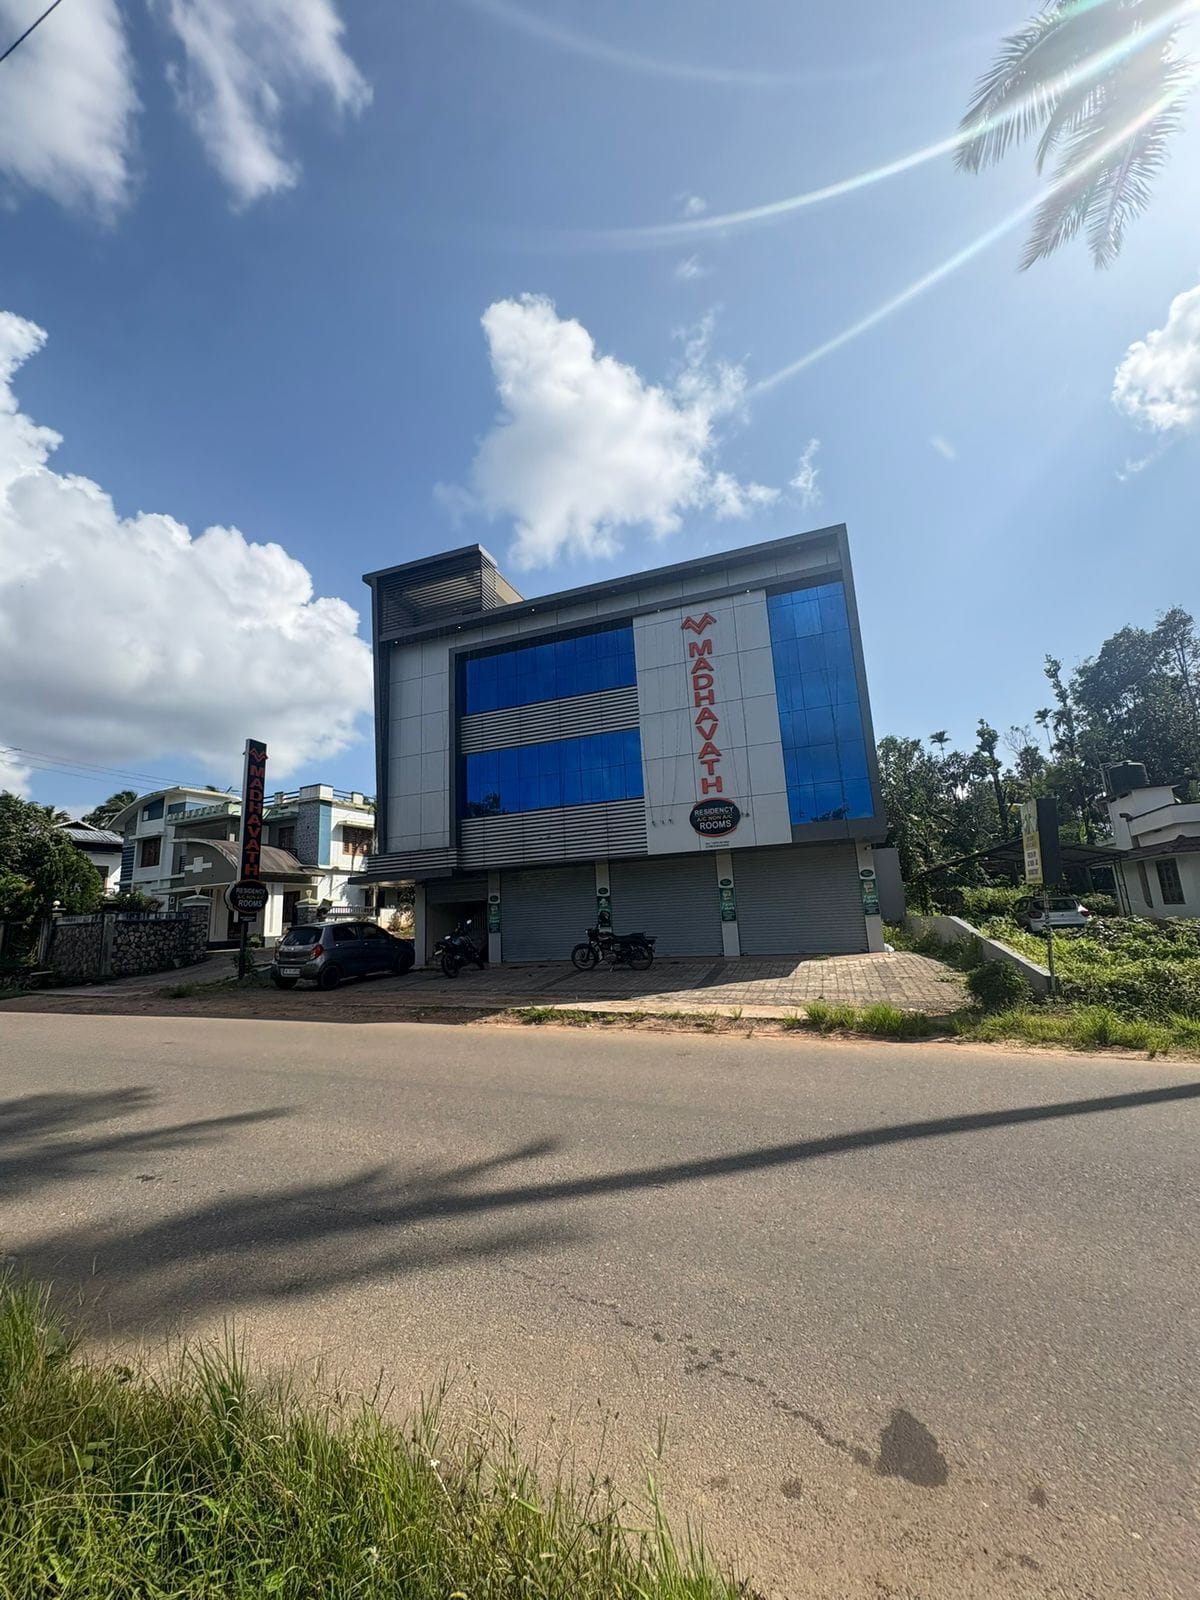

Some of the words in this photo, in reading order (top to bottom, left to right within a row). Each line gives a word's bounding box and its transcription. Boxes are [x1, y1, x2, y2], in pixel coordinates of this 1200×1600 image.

[688, 638, 724, 795] MADHAVATH
[694, 806, 735, 816] RESIDENCY
[244, 764, 265, 877] MADHAVATH
[699, 819, 732, 830] ROOMS
[235, 887, 266, 896] RESIDENCY
[239, 899, 263, 908] ROOMS
